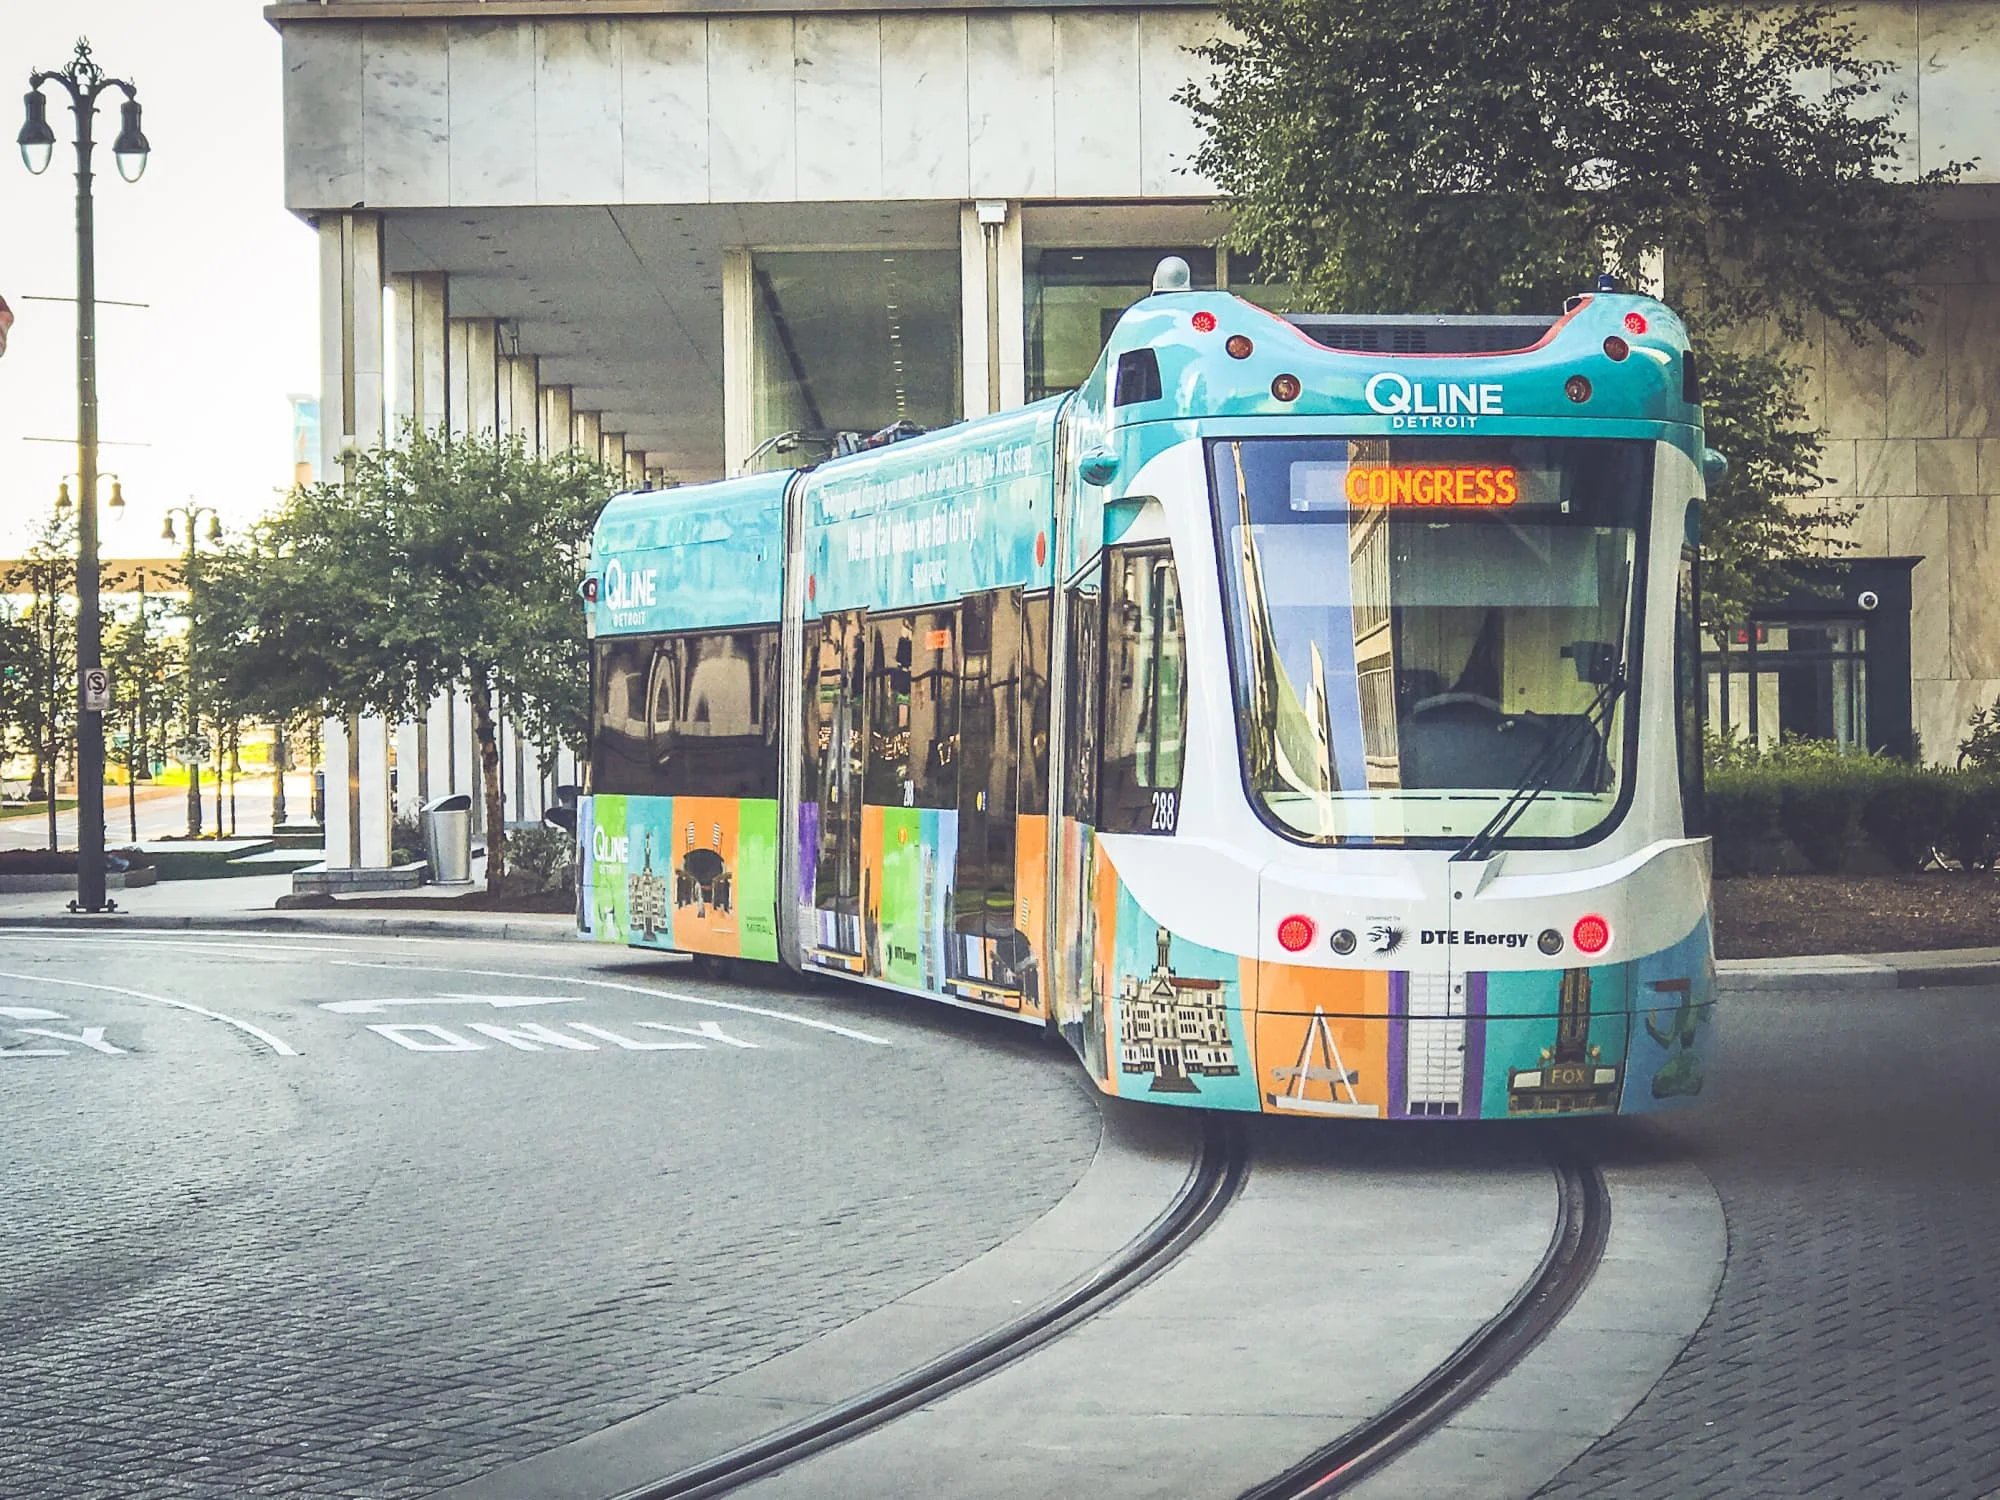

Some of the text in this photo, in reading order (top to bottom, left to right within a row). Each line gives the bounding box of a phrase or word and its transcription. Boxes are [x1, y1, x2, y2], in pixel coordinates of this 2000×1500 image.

[1365, 372, 1504, 415] QLINE
[1393, 416, 1478, 428] DETROIT
[1346, 469, 1517, 504] CONGRESS
[933, 503, 948, 546] fail
[949, 505, 960, 543] to
[605, 558, 657, 610] QLINE
[613, 611, 646, 627] DETROIT
[1151, 791, 1175, 831] 288
[593, 825, 629, 863] QLINE
[1421, 930, 1529, 947] DTE Energy
[366, 1022, 761, 1051] ONLY
[1551, 1068, 1585, 1084] FOX
